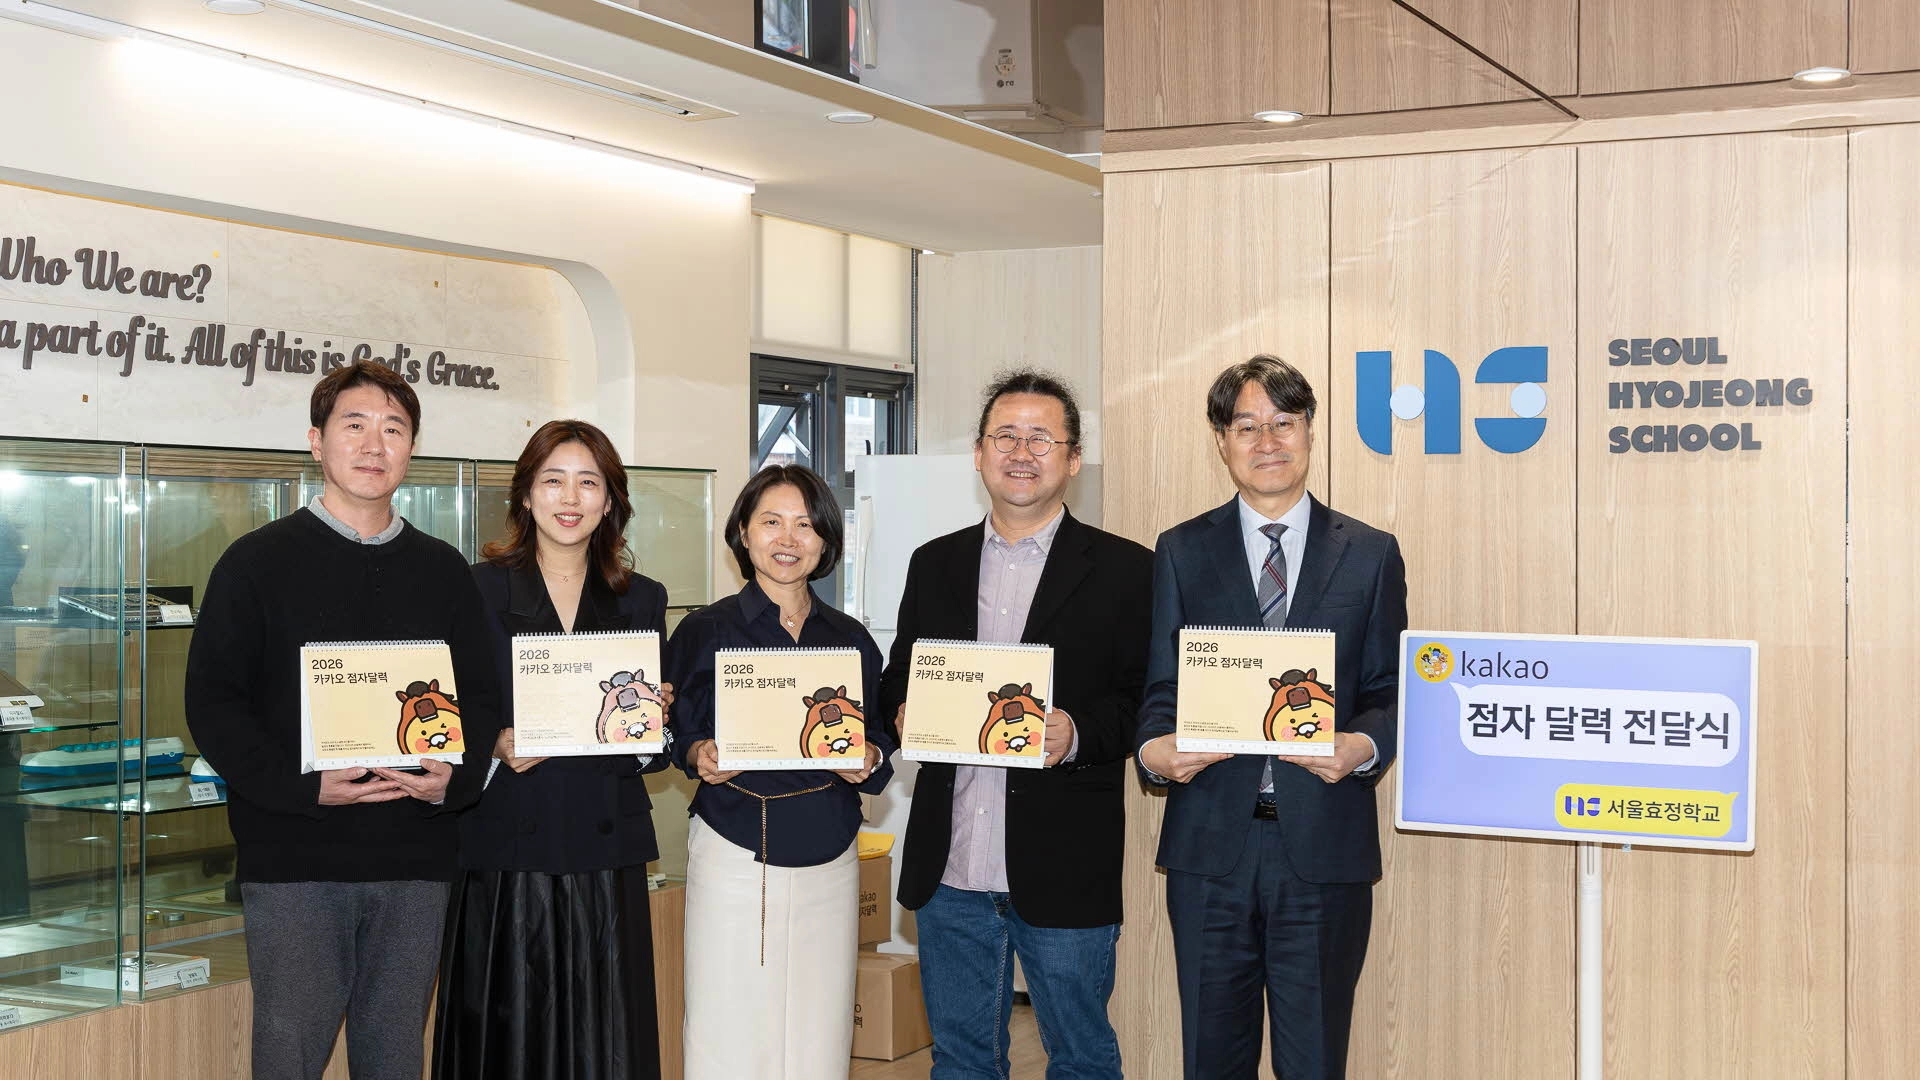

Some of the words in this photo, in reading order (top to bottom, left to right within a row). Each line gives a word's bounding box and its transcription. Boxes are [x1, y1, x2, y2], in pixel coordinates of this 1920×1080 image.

[74, 247, 137, 294] We
[139, 264, 212, 303] are?
[0, 319, 21, 349] a
[22, 320, 103, 370] part
[105, 315, 146, 377] of
[144, 322, 176, 363] it.
[180, 323, 229, 367] All
[230, 328, 267, 387] of
[264, 330, 317, 375] this
[321, 340, 346, 376] is
[427, 350, 500, 391] Grace.
[1608, 336, 1728, 366] SEOUL
[1608, 378, 1813, 409] HYOJEONG
[1609, 422, 1762, 454] SCHOOL
[1186, 641, 1219, 653] 2026
[519, 649, 550, 660] 2026
[917, 655, 946, 666] 2026
[311, 658, 344, 670] 2026
[520, 664, 550, 675] 카카오
[552, 662, 593, 674] 점자달력
[723, 664, 754, 675] 2026
[1186, 656, 1218, 668] 카카오
[1220, 657, 1263, 669] 점자달력
[1460, 650, 1550, 681] kakao
[314, 674, 346, 685] 카카오
[347, 671, 388, 684] 점자달력
[724, 678, 755, 689] 카카오
[756, 677, 796, 689] 점자달력
[915, 669, 944, 681] 카카오
[945, 670, 984, 683] 점자달력
[1467, 703, 1535, 740] 점자
[1545, 705, 1612, 744] 달력
[1622, 708, 1730, 750] 전달식
[1607, 799, 1721, 823] 서울효정학교
[859, 891, 877, 903] akao
[859, 904, 878, 918] 자달력
